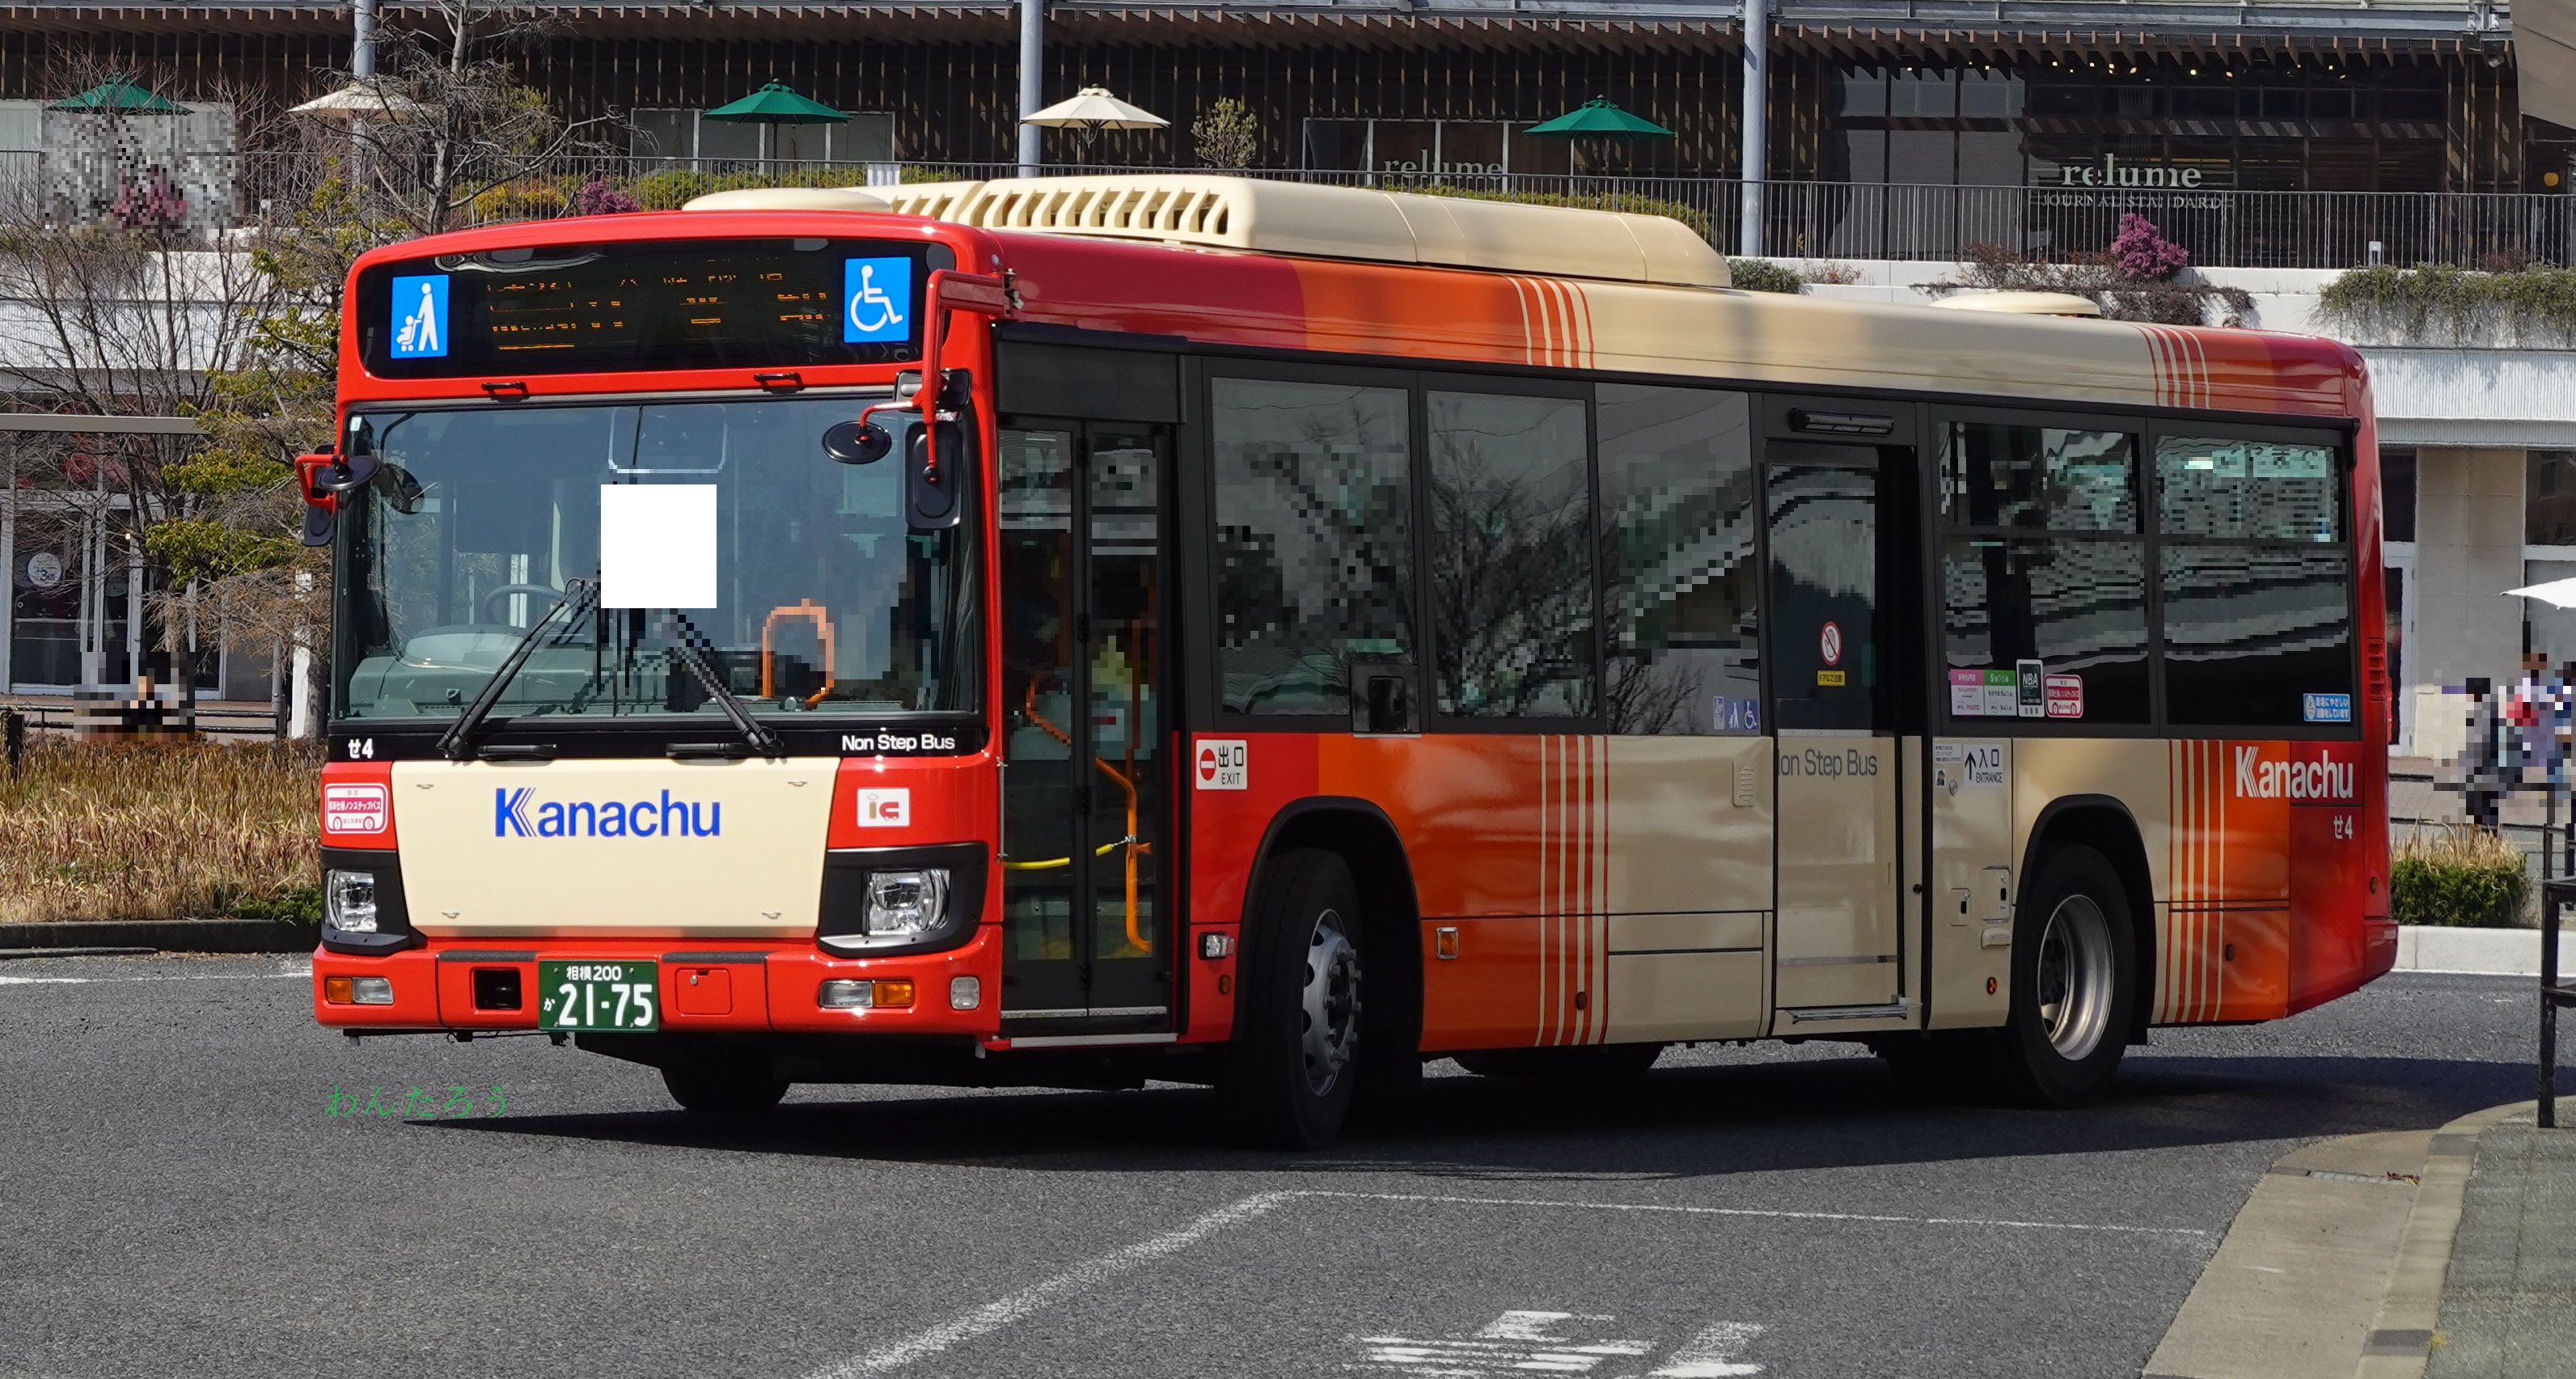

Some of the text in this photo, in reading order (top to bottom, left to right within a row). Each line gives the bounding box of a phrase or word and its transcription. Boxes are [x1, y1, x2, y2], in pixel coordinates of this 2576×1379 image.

[2062, 153, 2202, 188] relume
[1990, 674, 2009, 683] Suica
[2023, 673, 2038, 686] NBA
[348, 738, 374, 759] せ4
[842, 734, 955, 752] Non Step Bus
[1218, 745, 1244, 768] 出口
[1778, 747, 1877, 780] on Step Bus
[1978, 749, 1999, 768] 入口
[1221, 772, 1241, 785] EXIT
[1976, 772, 2003, 784] ENTRANCE
[2235, 746, 2354, 799] Kanachu
[495, 787, 721, 838] Kanachu
[2333, 814, 2353, 840] せ4
[558, 983, 652, 1026] 21-75
